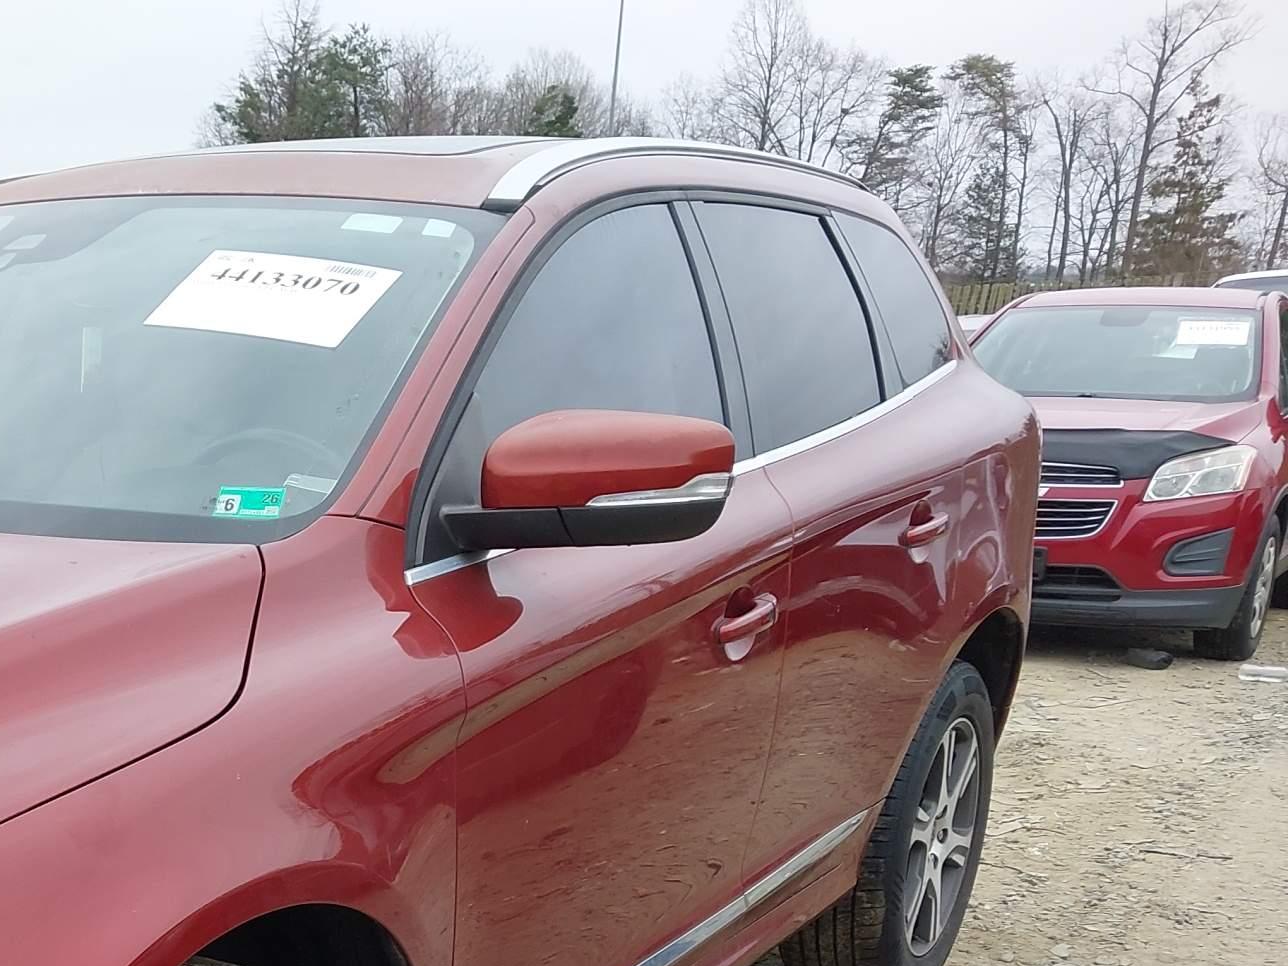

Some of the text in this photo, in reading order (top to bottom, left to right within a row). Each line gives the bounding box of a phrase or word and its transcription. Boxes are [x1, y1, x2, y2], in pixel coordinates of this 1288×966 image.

[210, 267, 361, 296] 44133070
[224, 498, 236, 511] 6
[261, 493, 280, 504] 26
